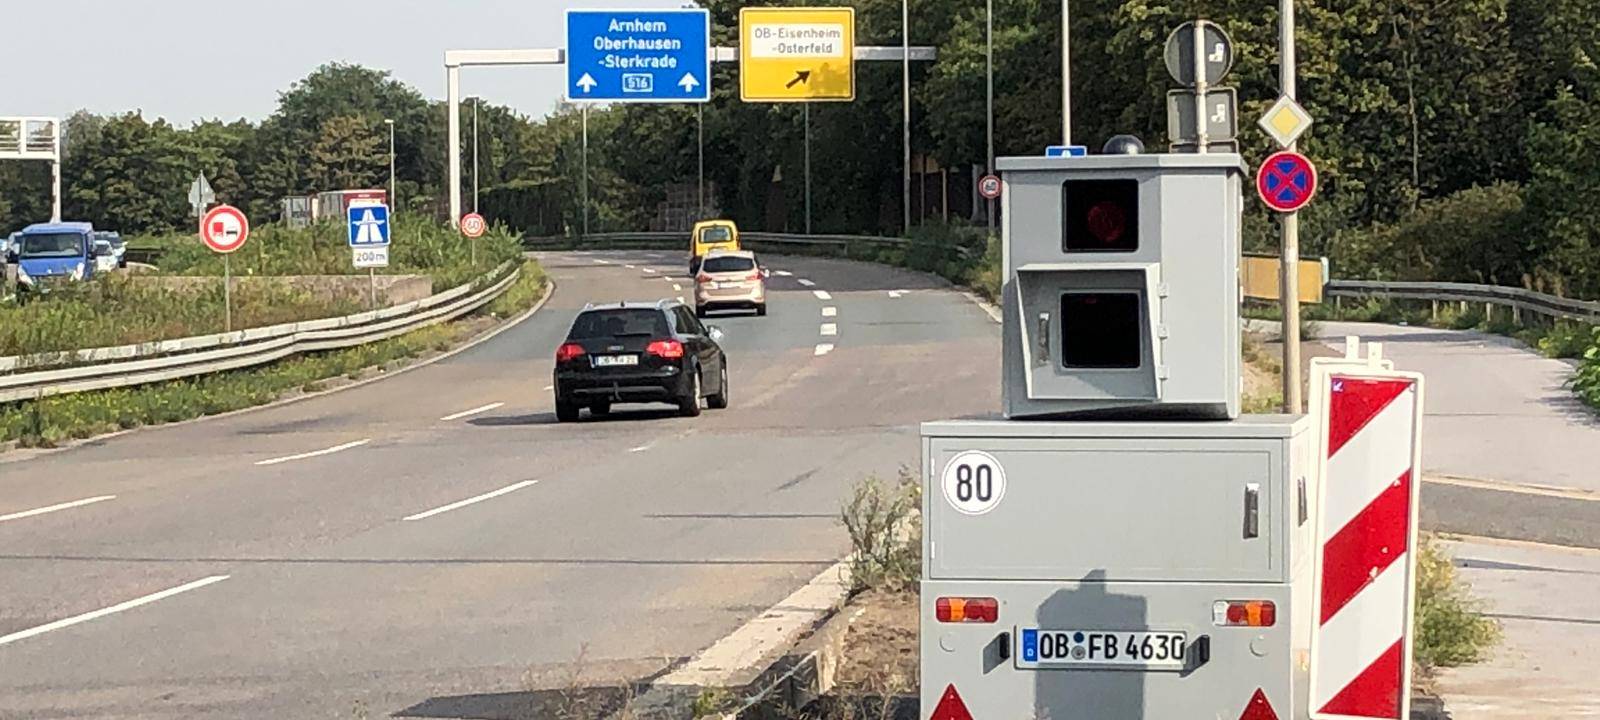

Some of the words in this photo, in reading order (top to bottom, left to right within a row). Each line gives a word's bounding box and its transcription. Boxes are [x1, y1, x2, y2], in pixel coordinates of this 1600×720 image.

[608, 18, 667, 32] Arnhem
[754, 27, 841, 39] OB-Eisenheim
[593, 36, 681, 50] Oberhausen
[772, 42, 833, 54] -Osterfeld
[598, 54, 677, 68] -Sterkrade
[955, 463, 993, 502] 80
[1039, 632, 1069, 659] OB
[1088, 633, 1118, 660] FB
[1125, 634, 1185, 661] 4630
